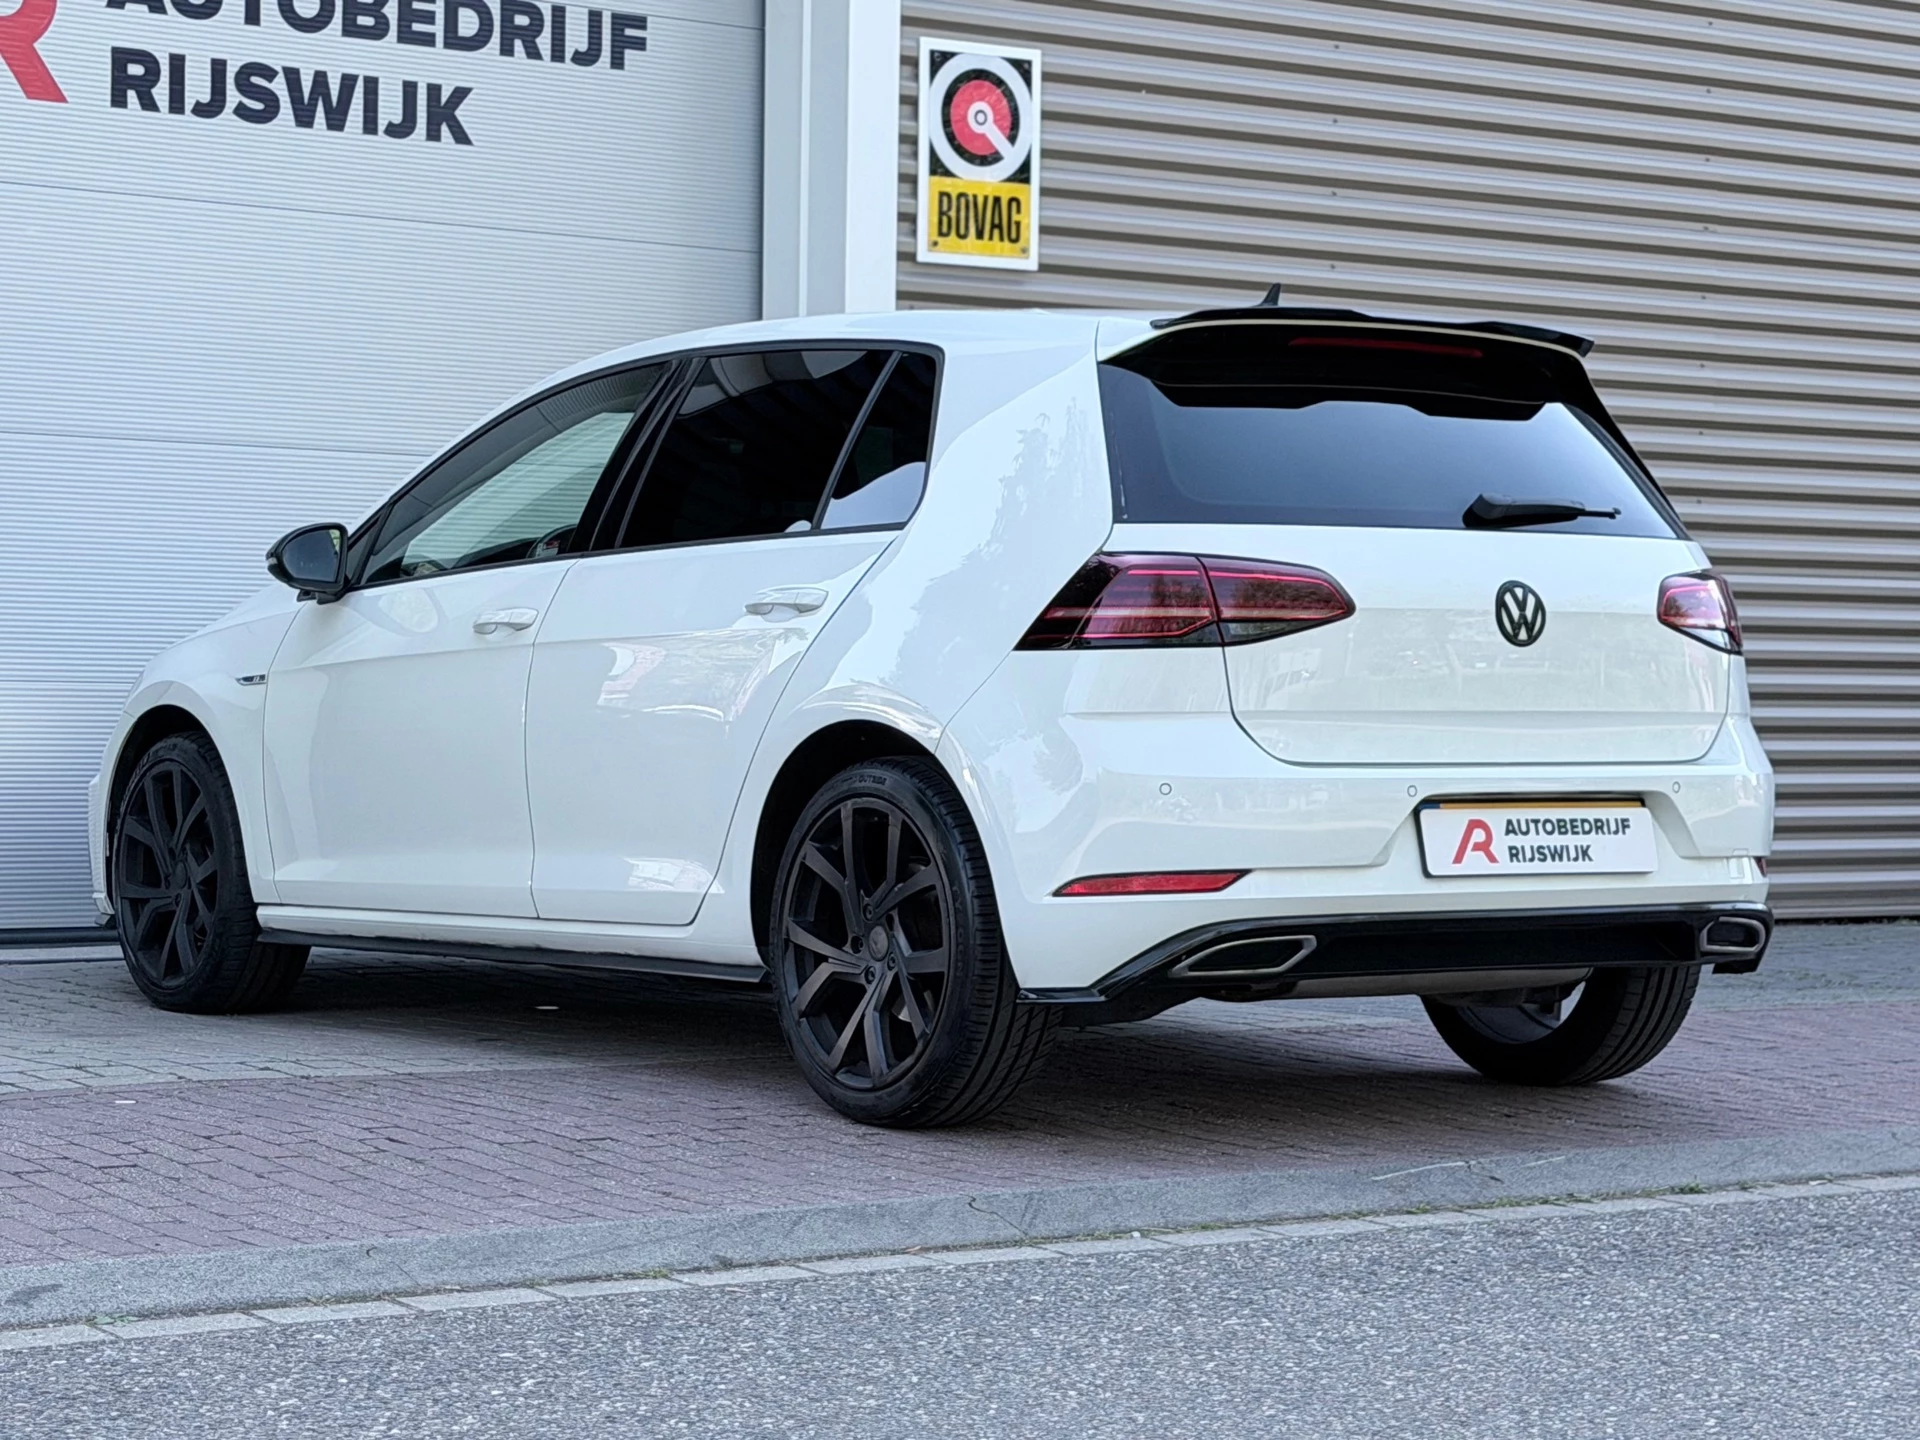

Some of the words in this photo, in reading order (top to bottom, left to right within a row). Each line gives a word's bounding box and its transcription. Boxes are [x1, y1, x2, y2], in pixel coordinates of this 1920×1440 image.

[110, 46, 474, 146] RIJSWIJK
[938, 191, 1021, 244] BOVAG
[1504, 818, 1631, 836] AUTOBEDRIJF
[1508, 844, 1594, 863] RIJSWIJK
